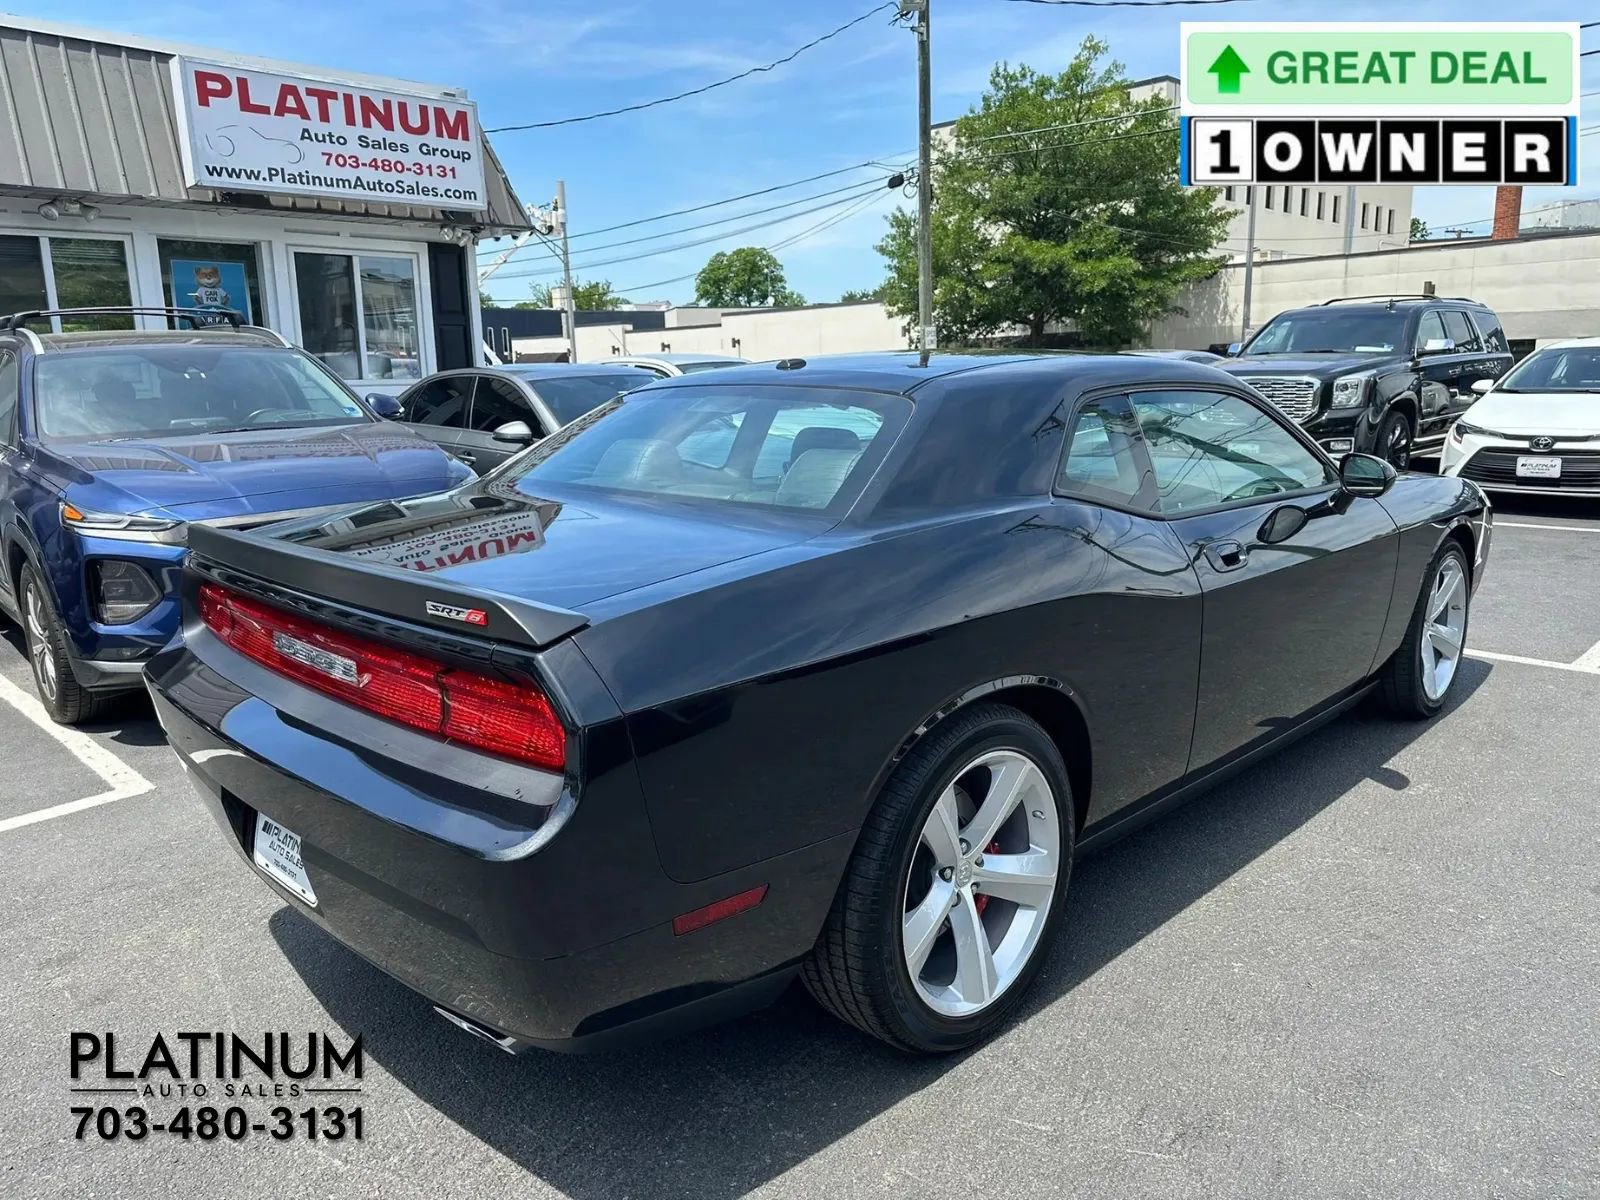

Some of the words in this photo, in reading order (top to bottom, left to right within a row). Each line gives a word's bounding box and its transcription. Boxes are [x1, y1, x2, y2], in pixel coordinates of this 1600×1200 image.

[194, 70, 470, 142] PLATINUM
[299, 128, 348, 146] Auto
[357, 135, 409, 154] Sales
[418, 143, 472, 162] Group
[321, 152, 457, 179] 703-480-3131
[205, 165, 478, 200] www.PlatinumAutoSales.com
[268, 841, 285, 857] AUTO
[285, 851, 304, 870] SALES
[271, 826, 302, 855] PLATIN
